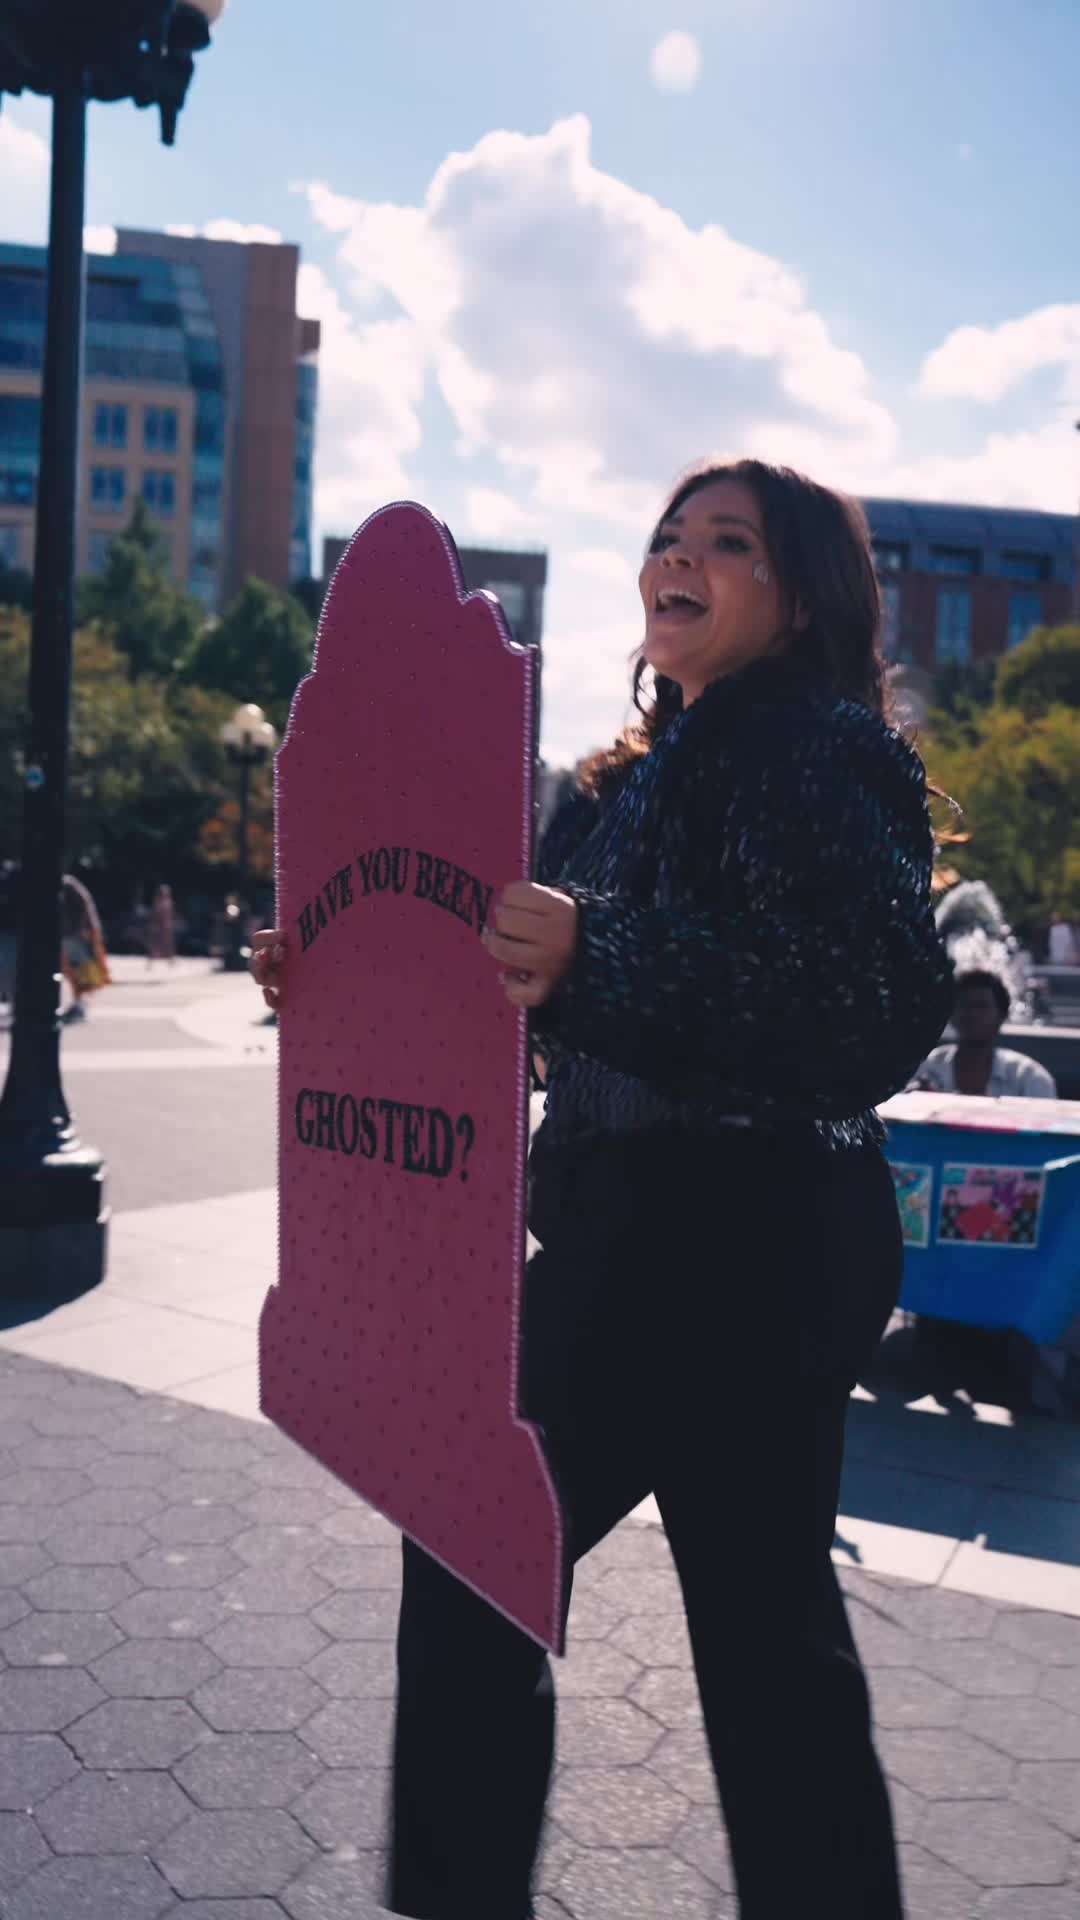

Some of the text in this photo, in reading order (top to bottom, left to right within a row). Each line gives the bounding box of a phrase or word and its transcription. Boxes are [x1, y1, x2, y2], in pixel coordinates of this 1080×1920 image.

[297, 847, 495, 952] HAVE YOU BEEN
[295, 1087, 476, 1183] GHOSTED?
